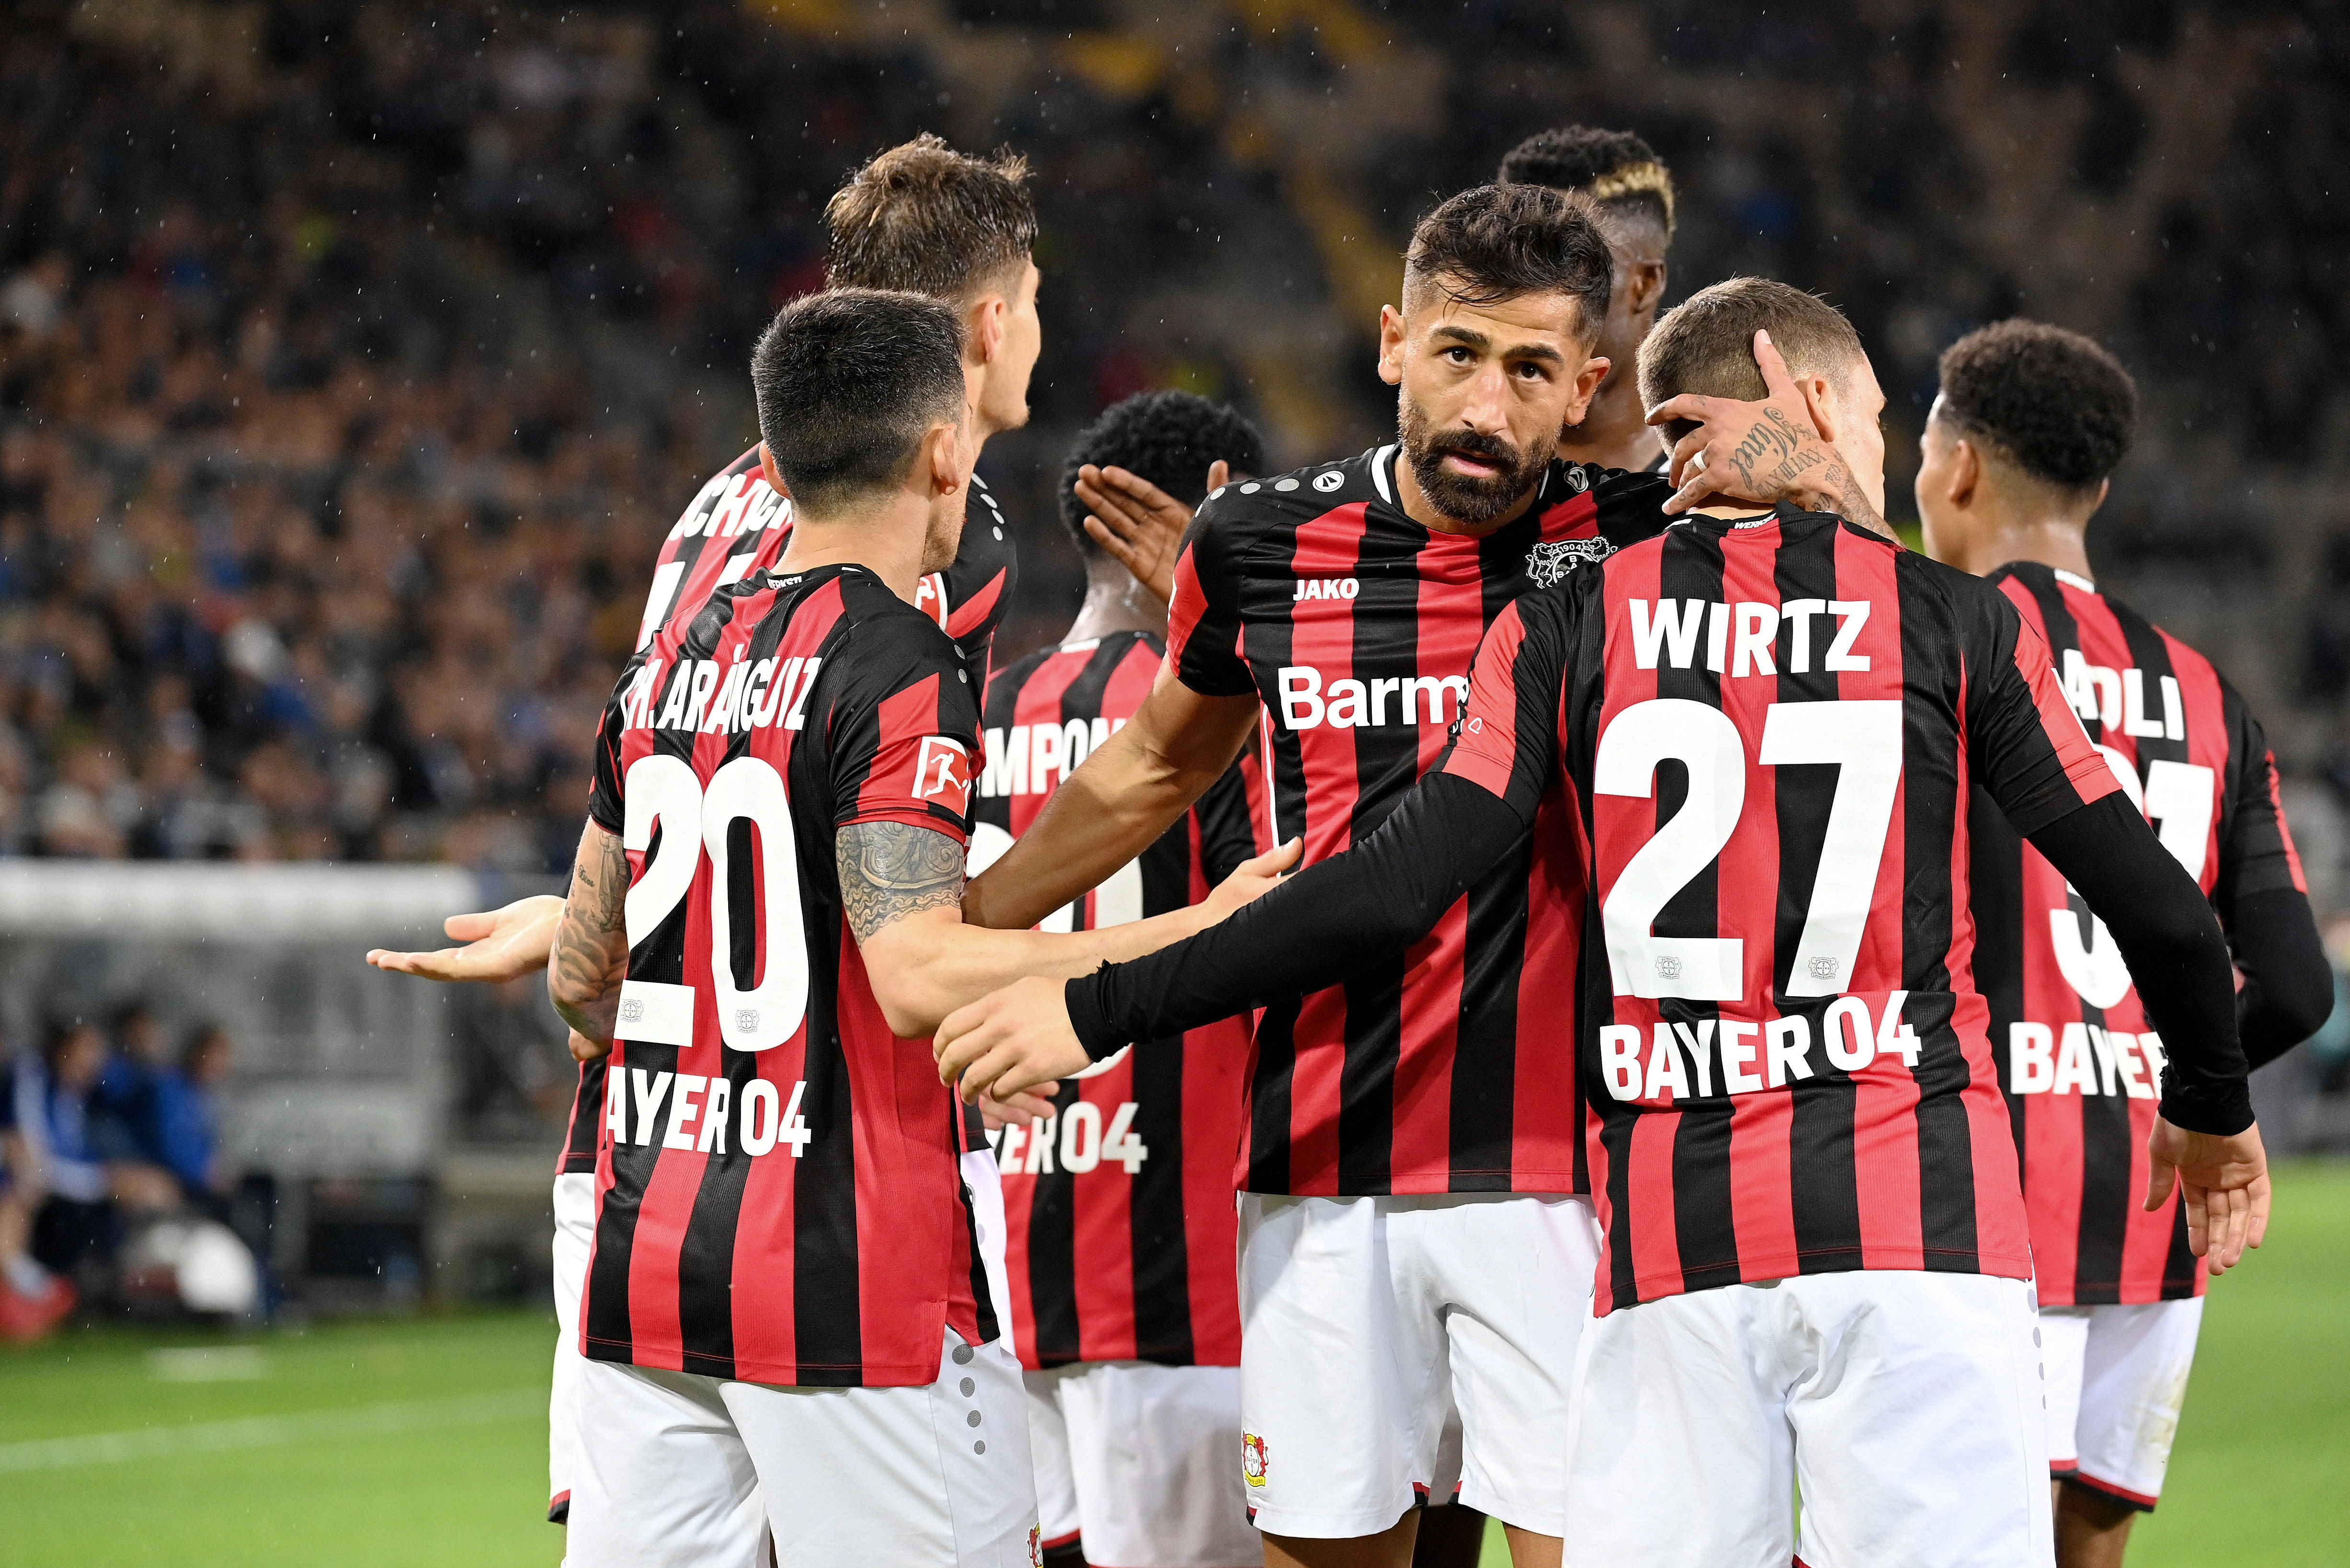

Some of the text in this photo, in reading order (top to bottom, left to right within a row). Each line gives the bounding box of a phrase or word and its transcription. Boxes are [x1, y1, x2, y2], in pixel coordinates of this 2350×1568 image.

[1293, 578, 1359, 601] JAKO
[1559, 544, 1581, 553] 1904
[1628, 598, 1871, 678] WIRTZ
[1594, 698, 1904, 1001] 27
[614, 754, 810, 1052] 20
[1599, 989, 1922, 1101] BAYER 04
[605, 1065, 811, 1158] AYER 04
[1060, 1101, 1148, 1174] 04
